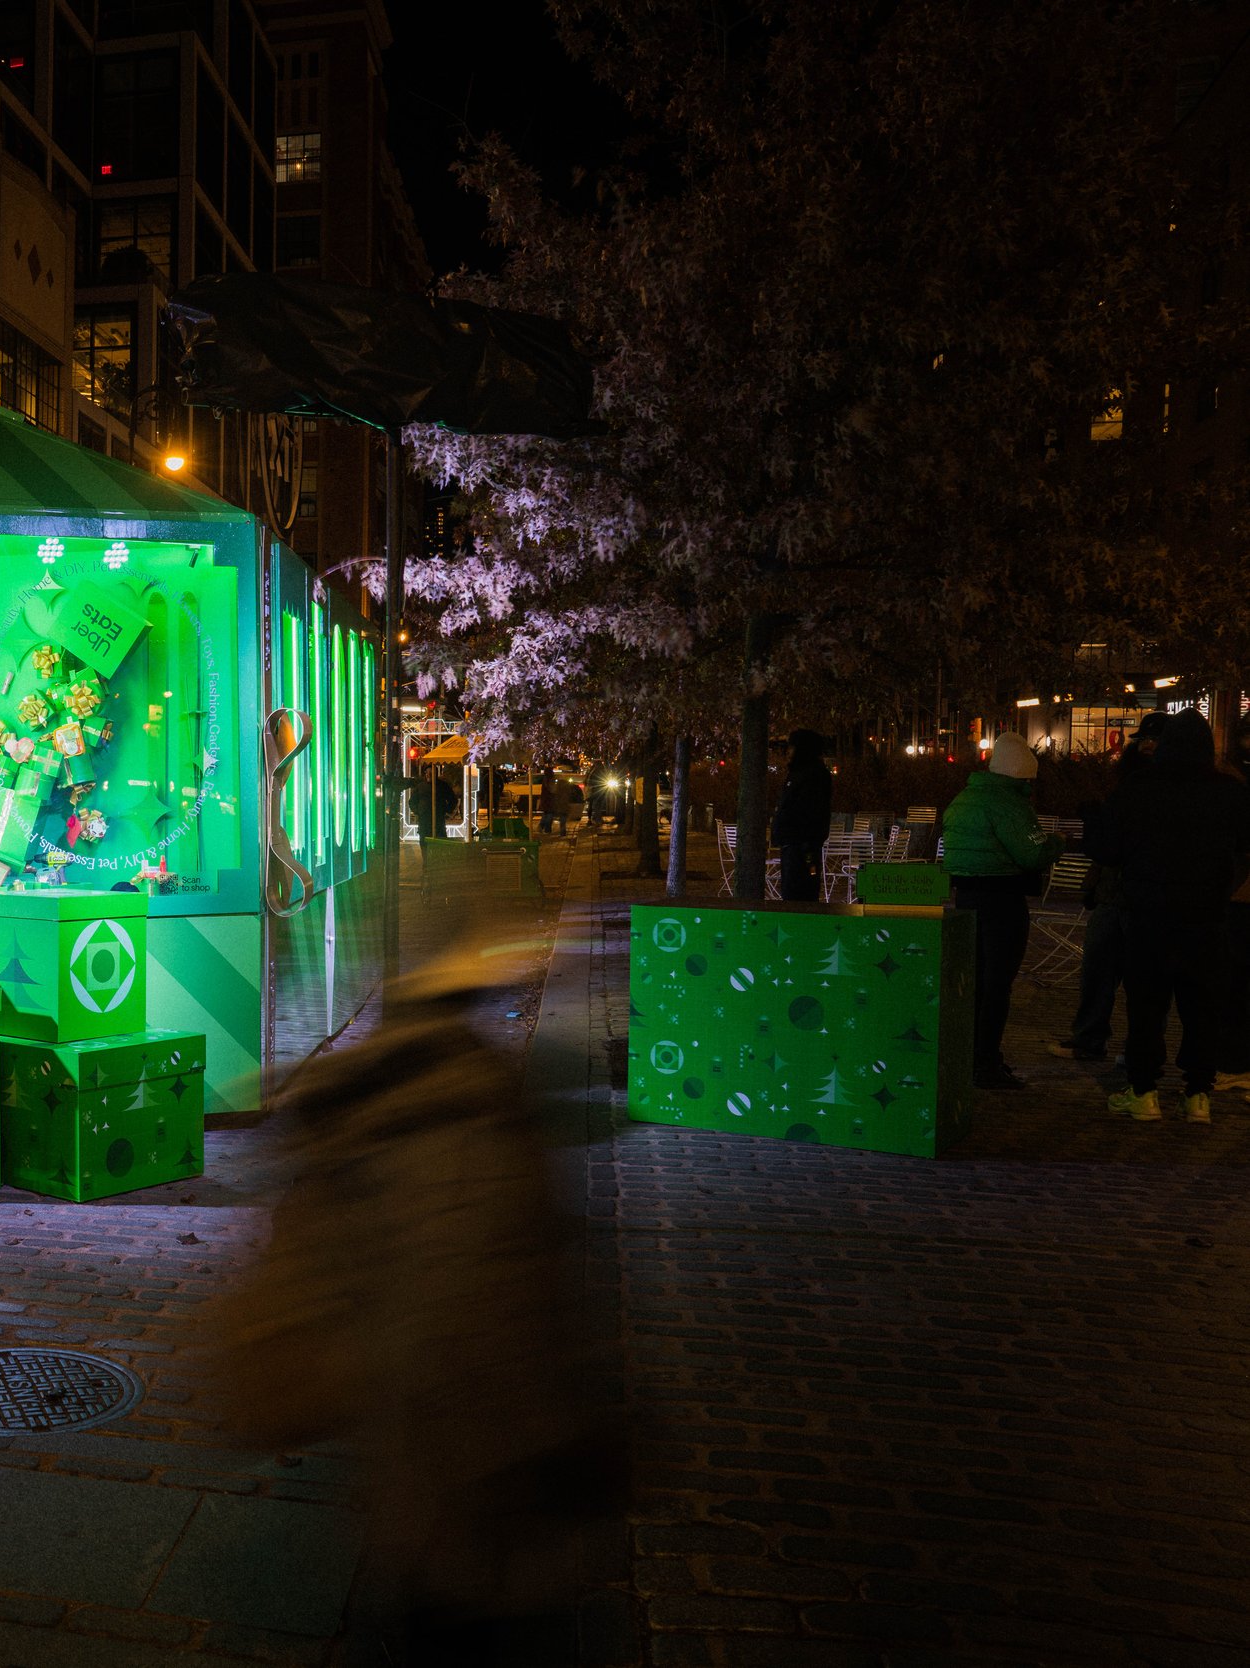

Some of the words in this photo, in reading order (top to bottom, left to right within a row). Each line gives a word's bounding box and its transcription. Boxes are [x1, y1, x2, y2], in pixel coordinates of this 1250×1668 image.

[52, 569, 64, 580] &
[17, 576, 52, 605] Home
[82, 603, 123, 641] Eats
[70, 621, 111, 658] Uber
[208, 671, 221, 724] Fashion,
[157, 821, 191, 850] Home
[120, 851, 146, 869] DIY,
[146, 846, 157, 859] &
[97, 856, 118, 870] Pet
[181, 876, 201, 884] Scan
[181, 884, 190, 892] to
[191, 884, 211, 893] shop
